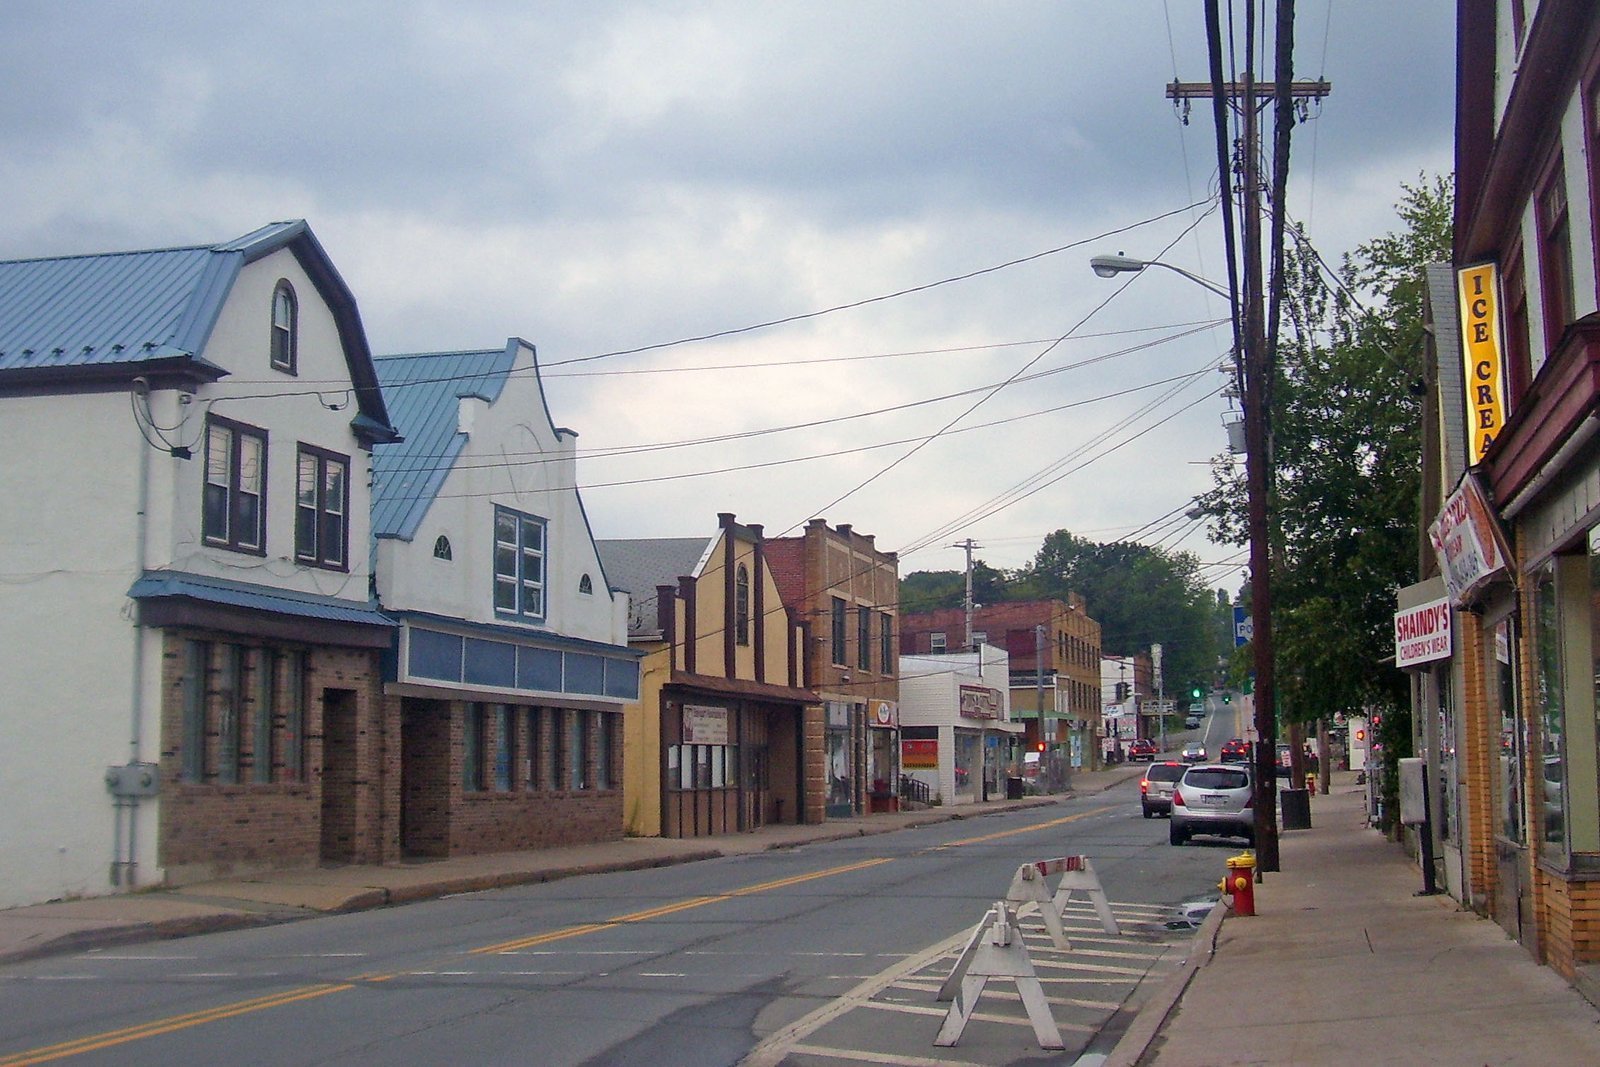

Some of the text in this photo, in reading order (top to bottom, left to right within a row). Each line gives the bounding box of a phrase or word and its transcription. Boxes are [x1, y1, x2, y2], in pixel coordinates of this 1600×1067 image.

[1472, 275, 1489, 344] ICE
[1397, 603, 1448, 642] SHAINDY'S
[1400, 635, 1448, 660] CHILDREN'S WEAR
